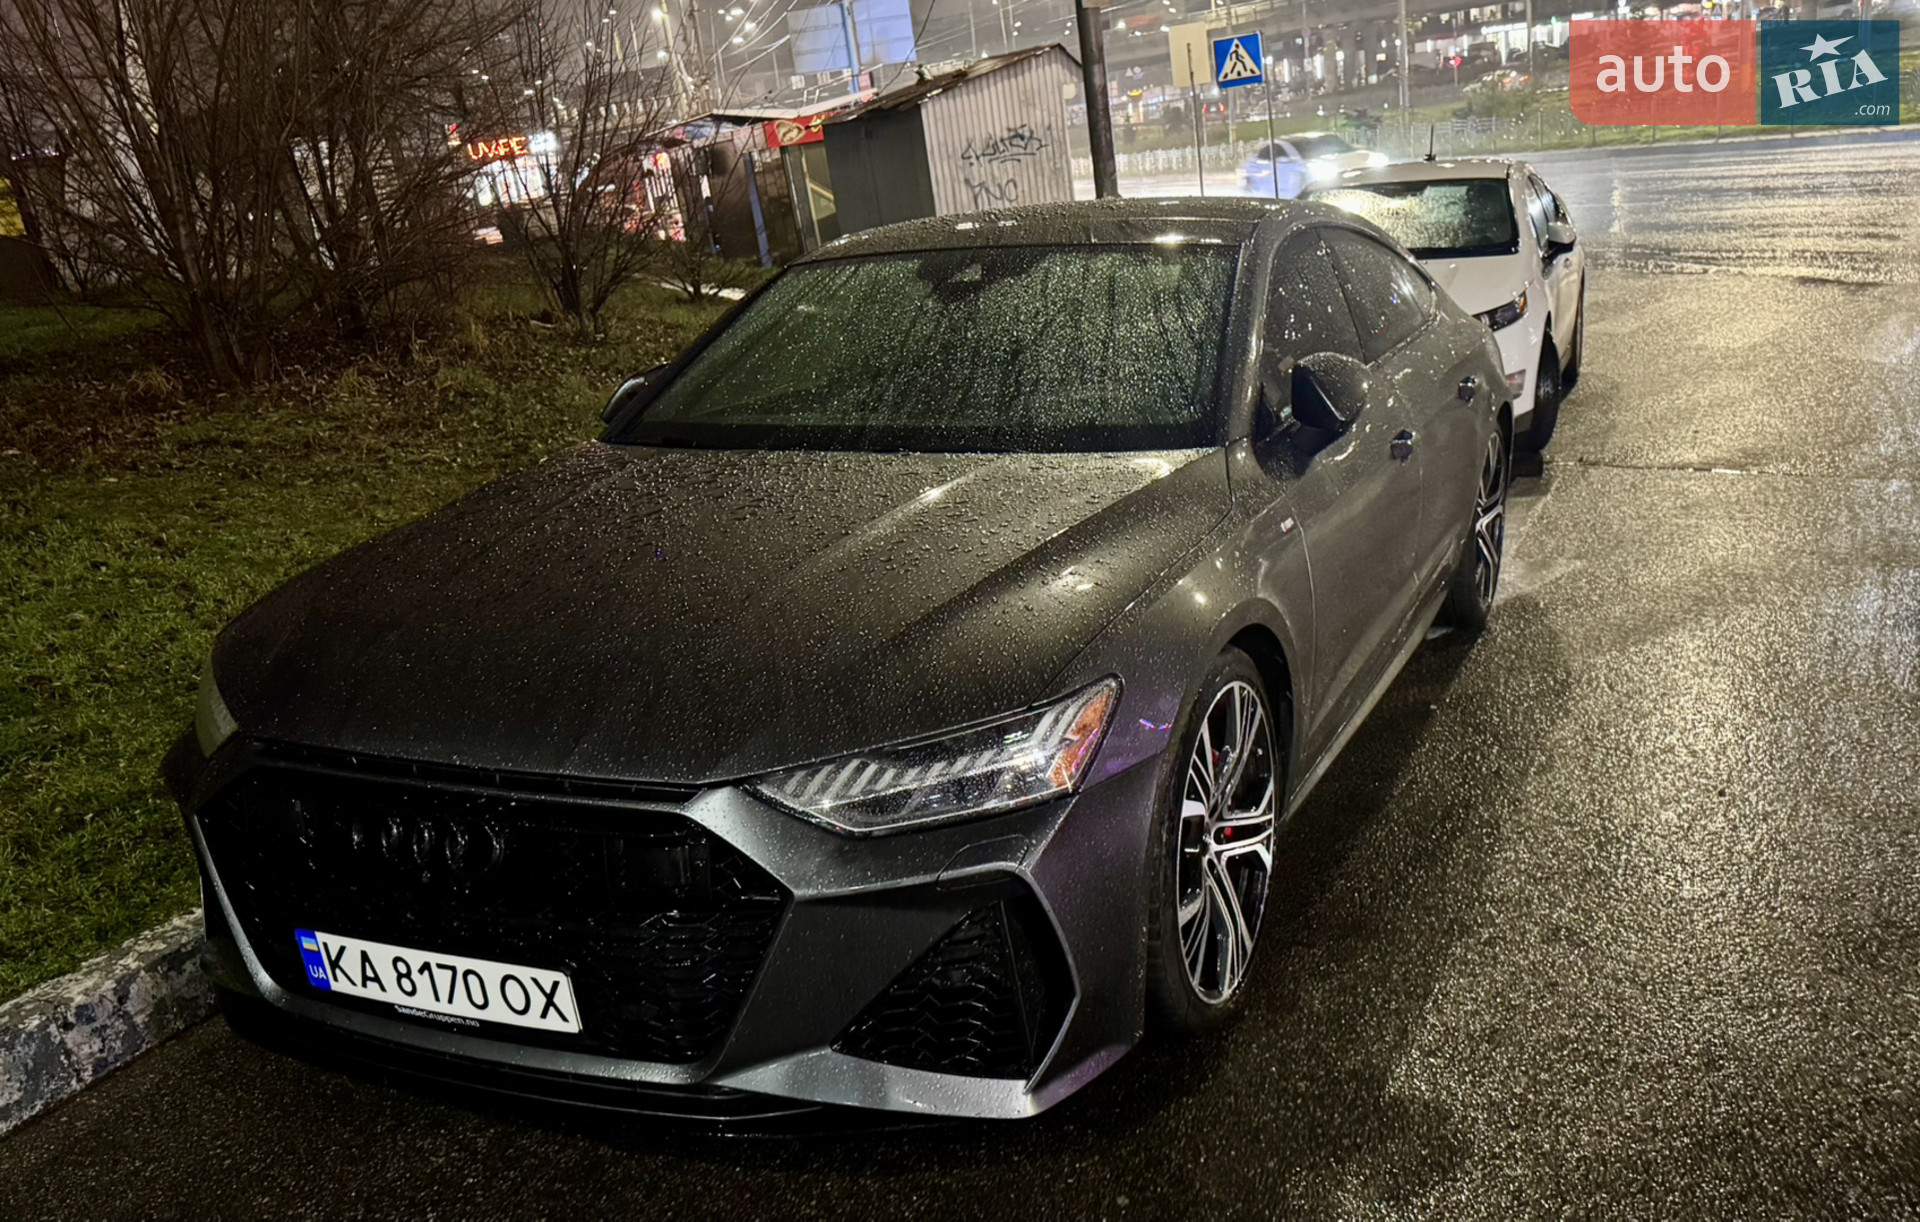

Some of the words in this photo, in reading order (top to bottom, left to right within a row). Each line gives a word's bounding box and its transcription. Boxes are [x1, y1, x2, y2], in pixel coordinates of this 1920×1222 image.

[309, 964, 327, 981] UA
[322, 941, 387, 993] KA
[391, 955, 489, 1010] 8170
[500, 973, 570, 1023] OX
